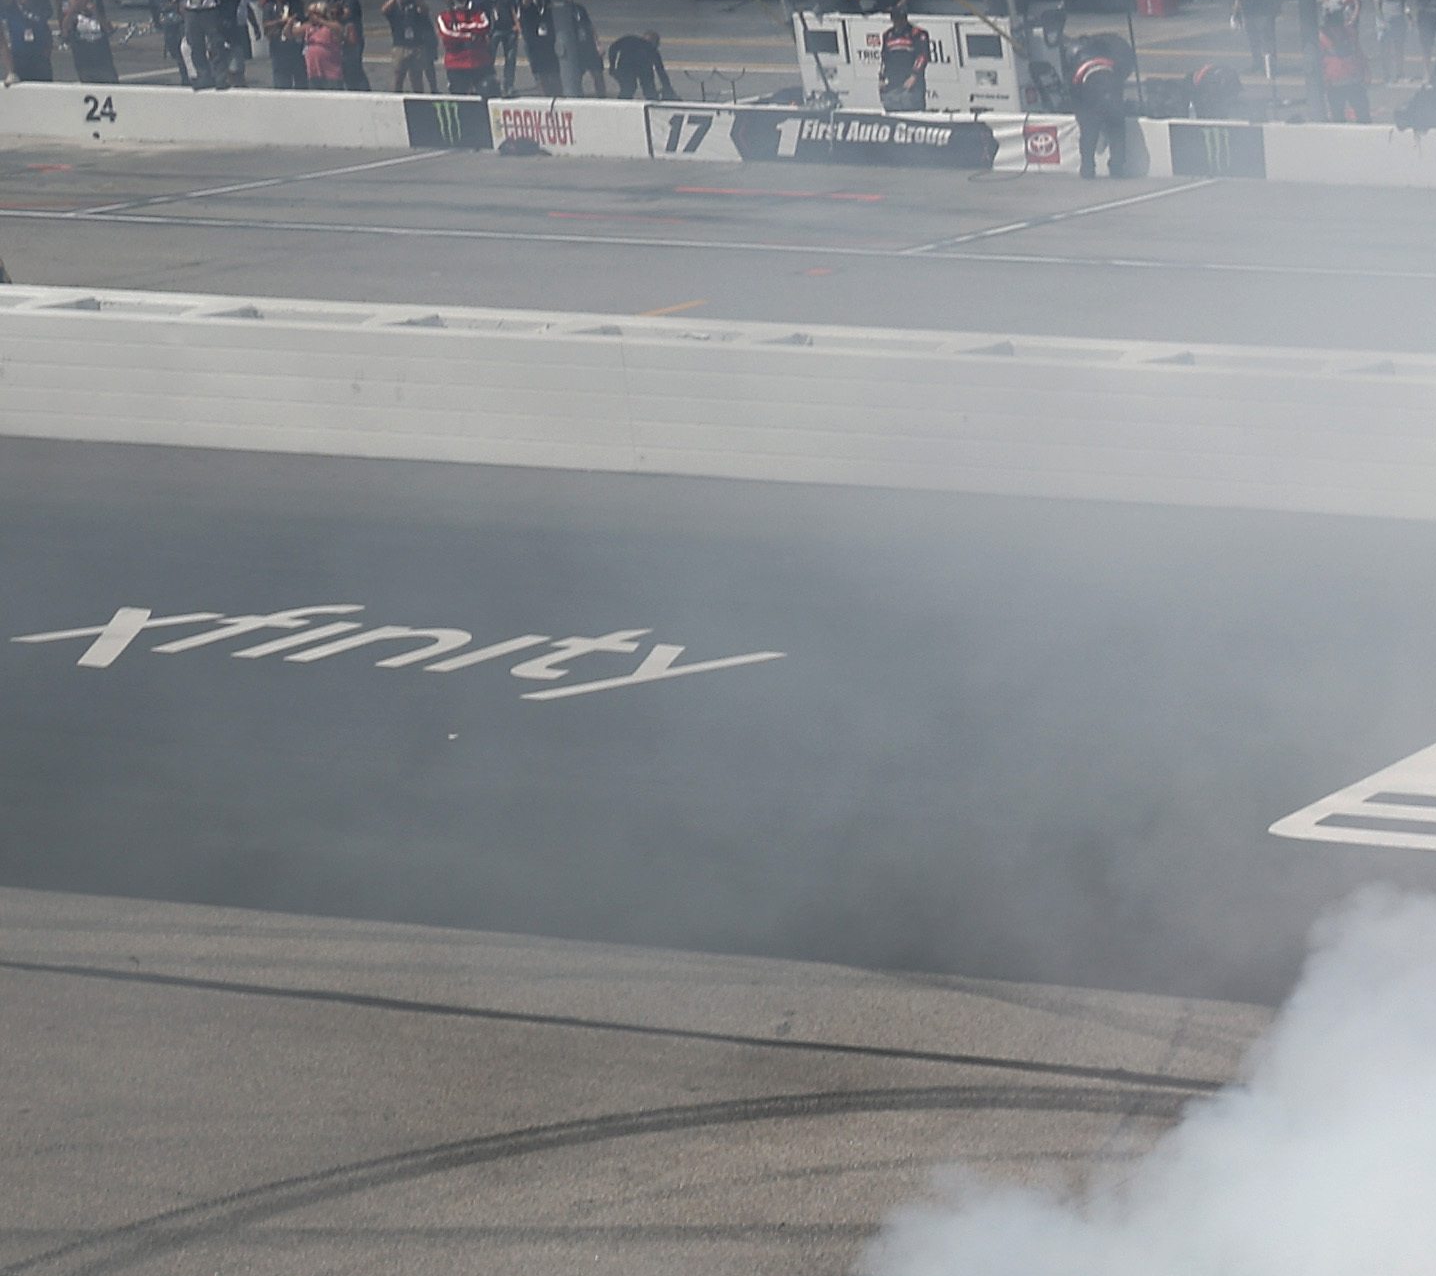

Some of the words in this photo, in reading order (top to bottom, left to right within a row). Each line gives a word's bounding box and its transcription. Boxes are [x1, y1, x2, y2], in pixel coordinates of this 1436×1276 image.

[857, 49, 881, 60] TRIC
[83, 95, 117, 123] 24
[502, 109, 545, 145] COOK
[546, 110, 574, 146] OUT
[664, 115, 715, 153] 17
[802, 119, 844, 140] First
[846, 121, 890, 143] Auto
[893, 122, 952, 146] Group
[10, 604, 789, 701] xfinity
